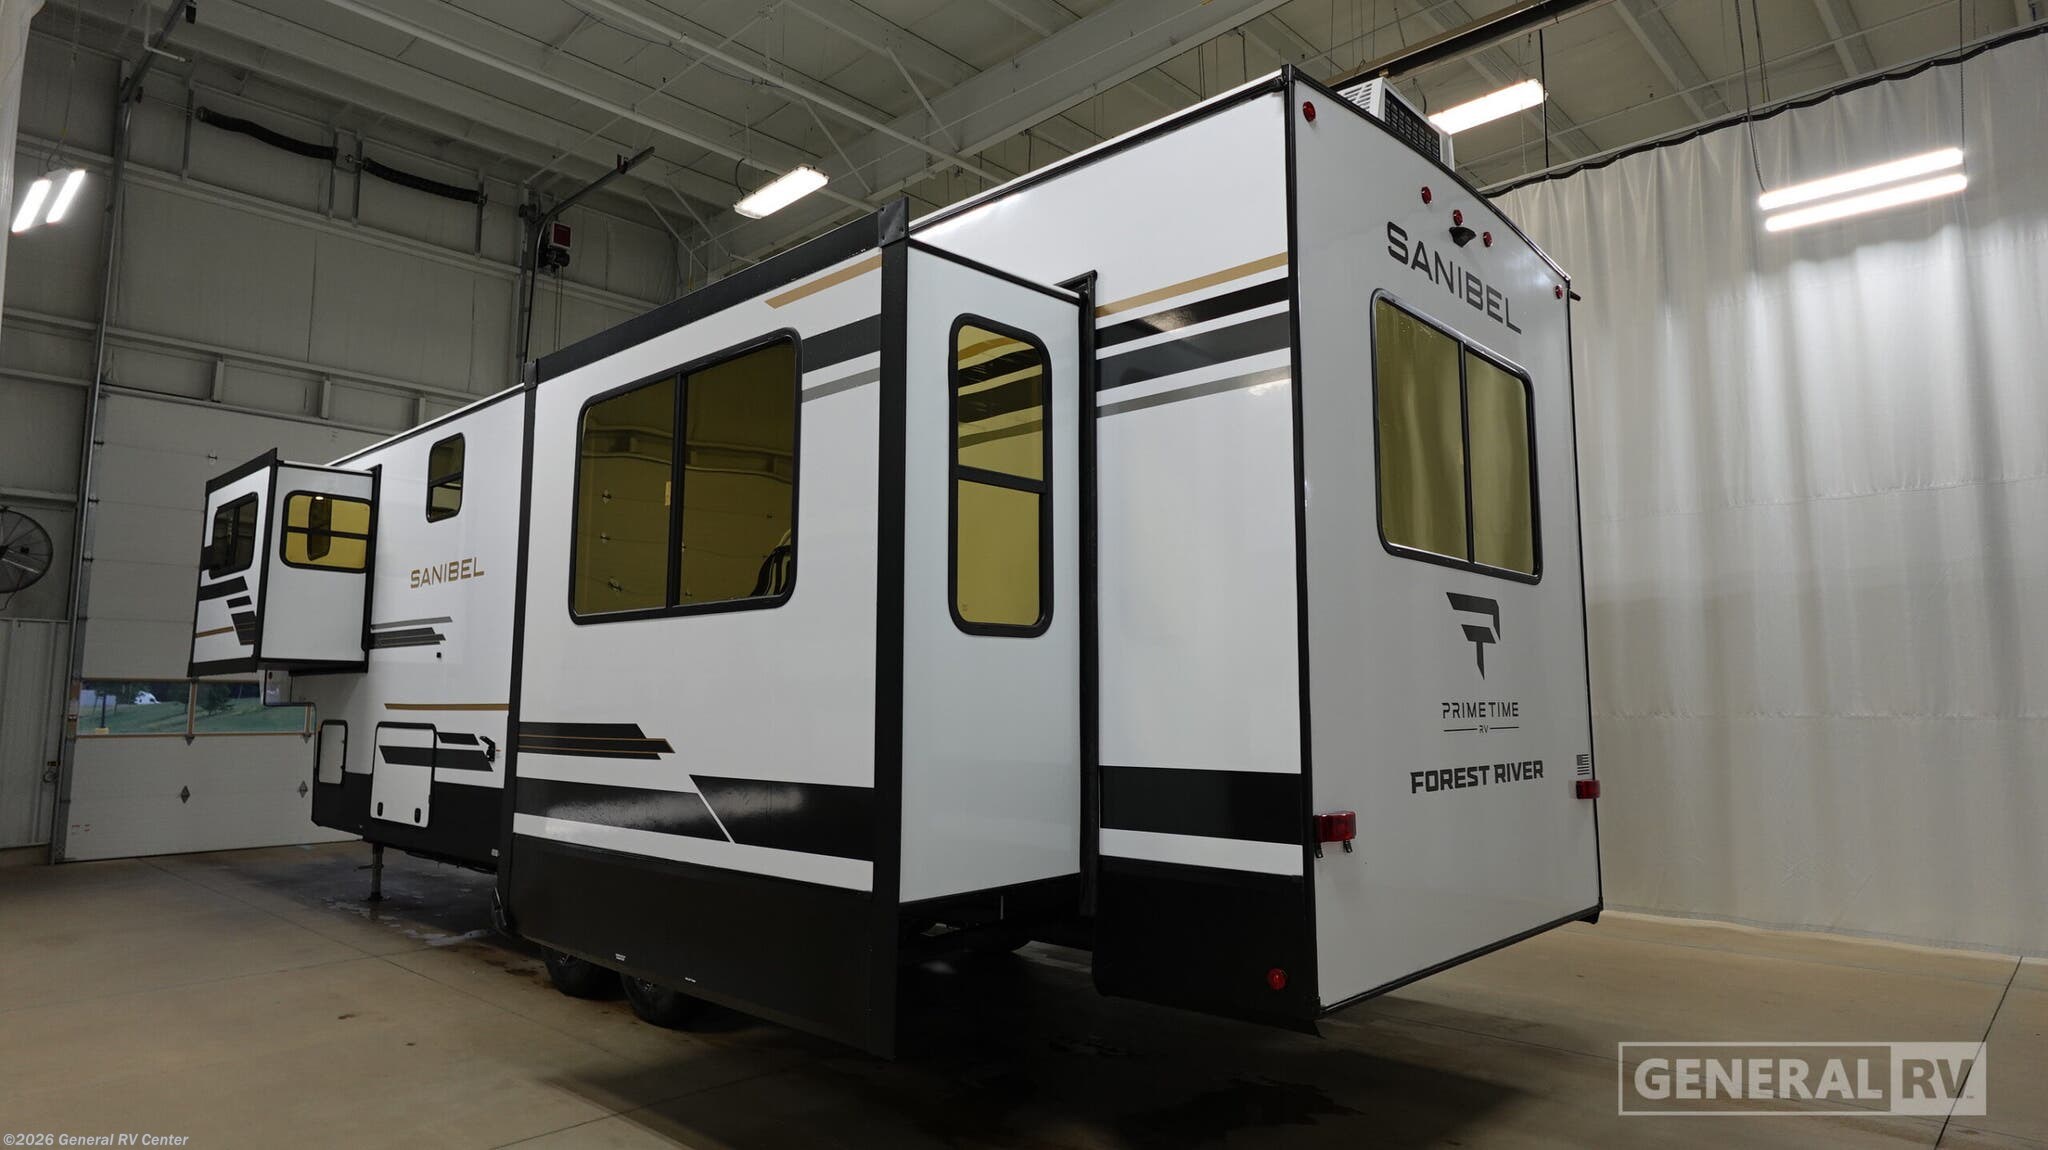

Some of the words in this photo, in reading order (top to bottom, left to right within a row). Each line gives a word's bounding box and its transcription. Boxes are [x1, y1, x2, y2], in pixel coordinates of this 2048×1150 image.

[1387, 221, 1522, 335] SANIBEL
[410, 557, 485, 589] SANIBEL
[1479, 724, 1489, 734] RV
[1410, 765, 1490, 794] FOREST
[1494, 760, 1544, 784] RIVER
